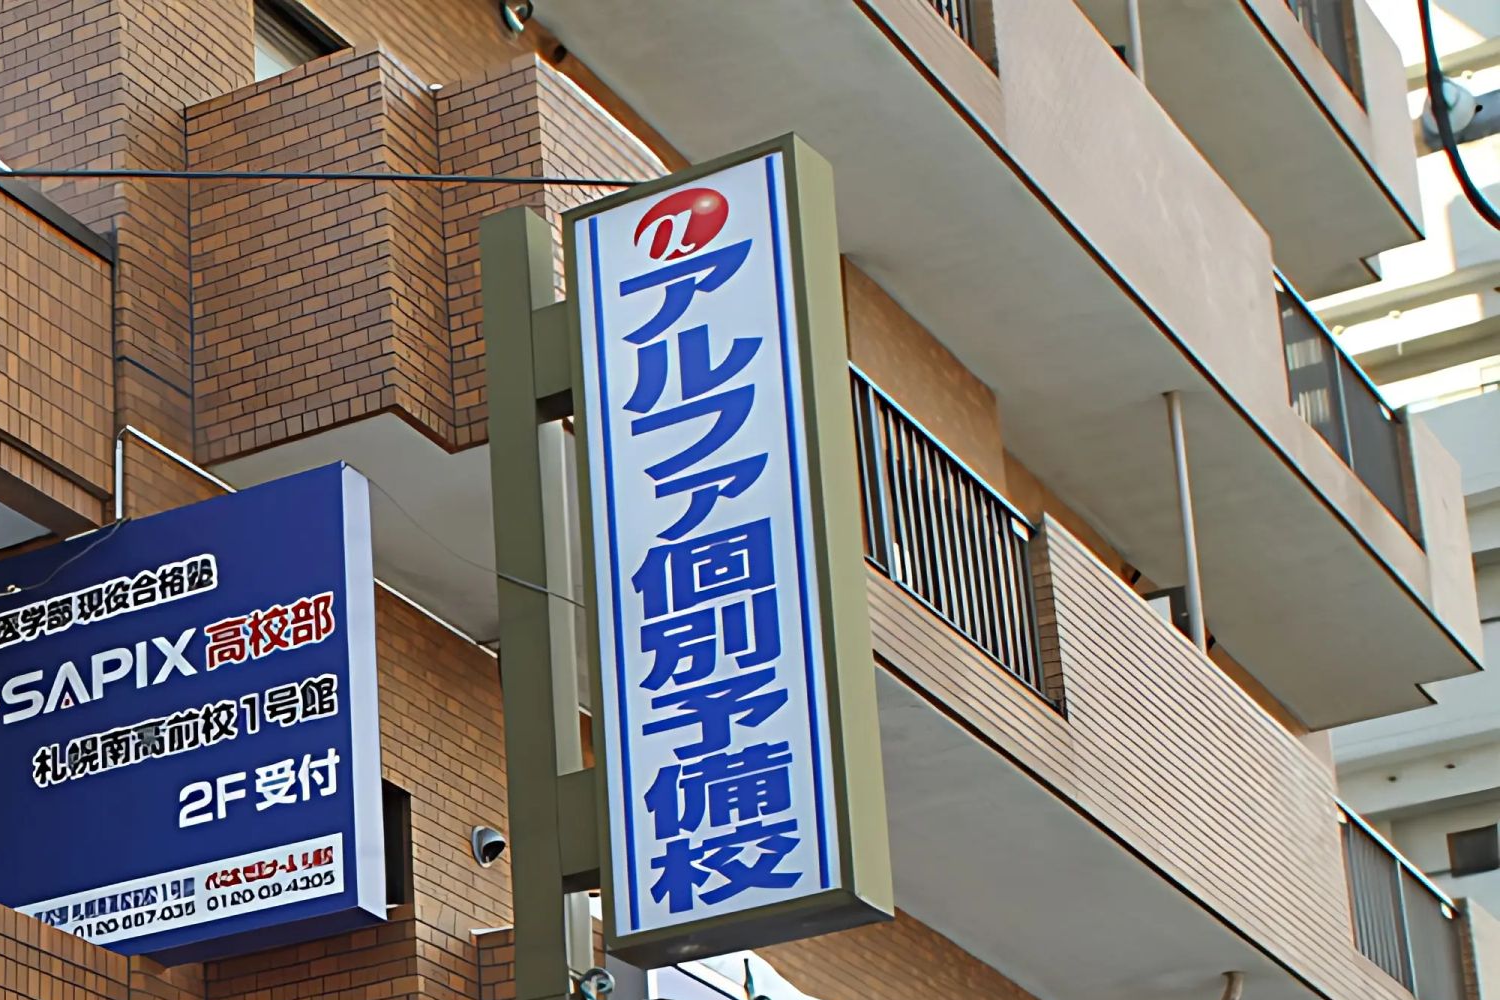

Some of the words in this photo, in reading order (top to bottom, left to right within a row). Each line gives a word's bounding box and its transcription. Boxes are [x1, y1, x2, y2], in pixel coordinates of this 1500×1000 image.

[204, 591, 336, 672] 高校部
[619, 238, 804, 914] アルファ個別予備校
